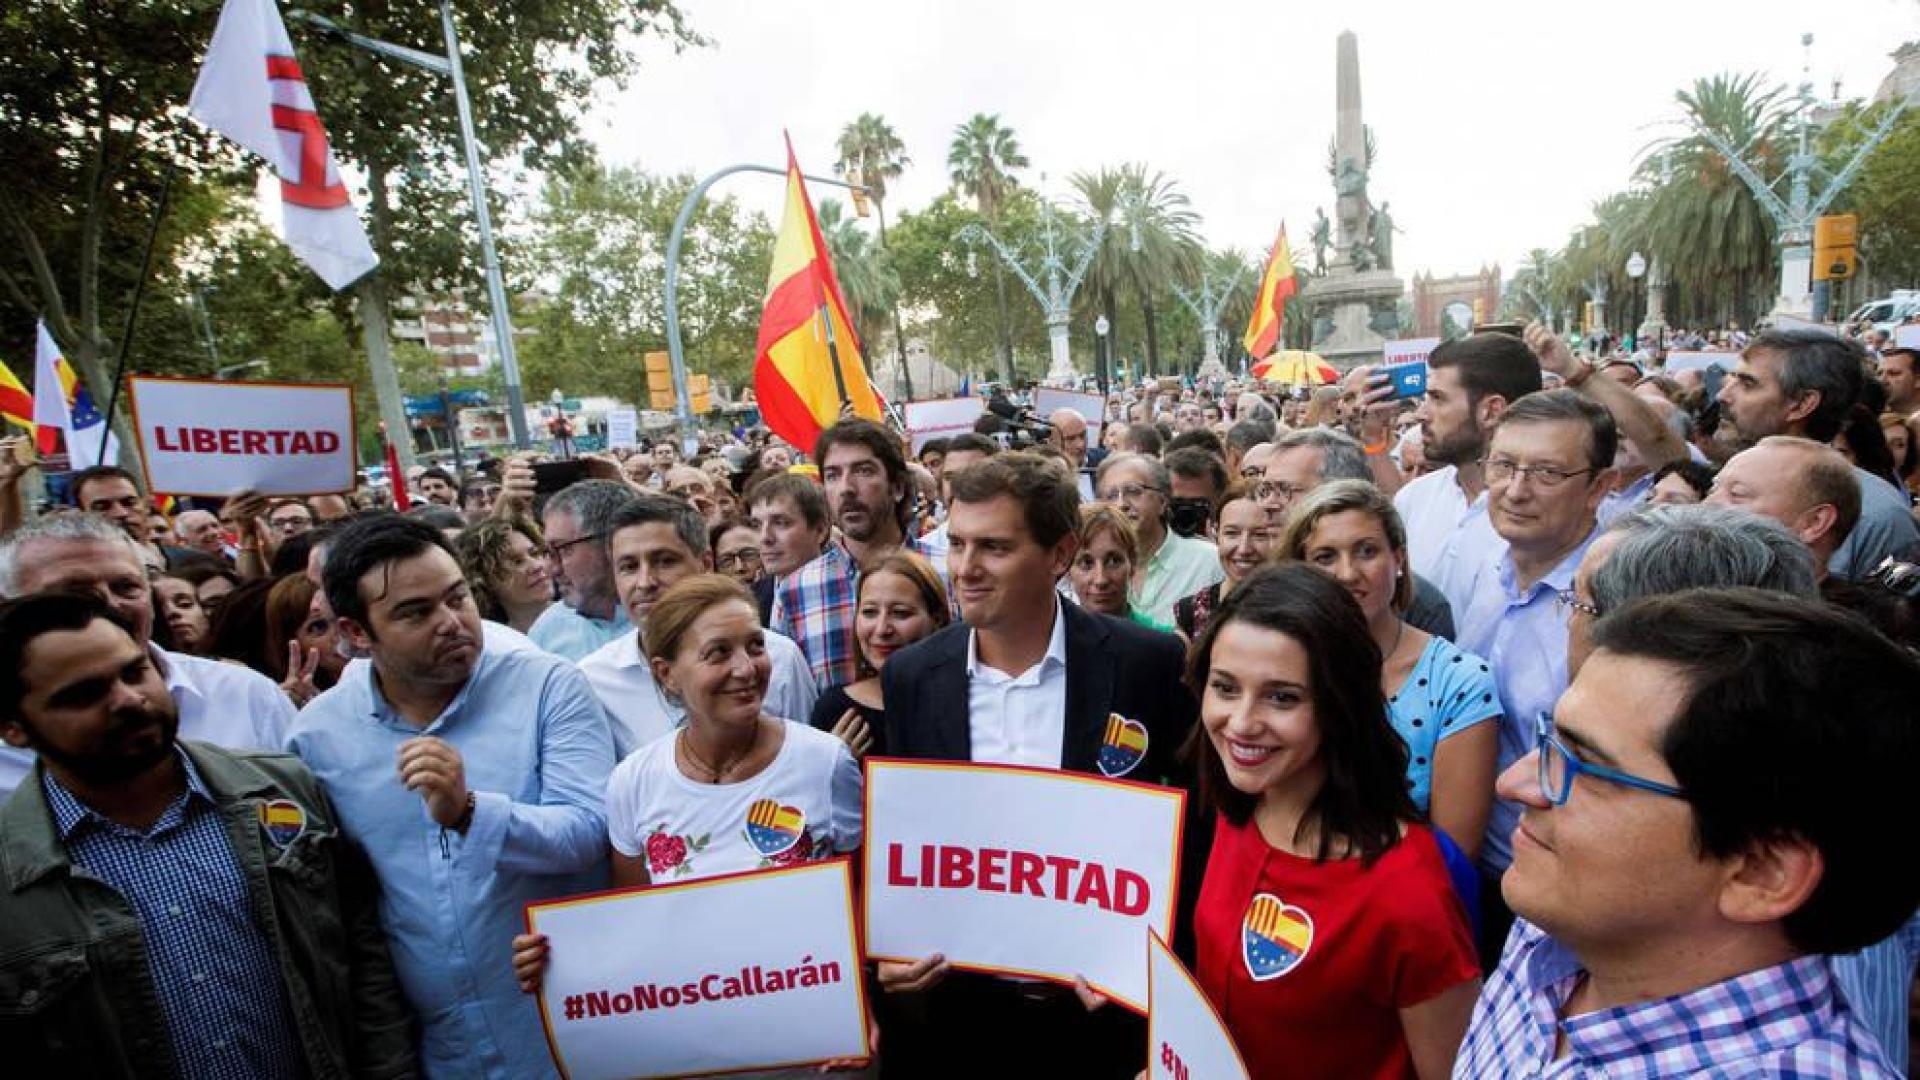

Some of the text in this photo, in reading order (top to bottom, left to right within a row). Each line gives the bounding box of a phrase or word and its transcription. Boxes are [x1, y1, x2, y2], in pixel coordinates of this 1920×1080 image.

[154, 426, 340, 454] LIBERTAD
[888, 843, 1151, 916] LIBERTAD
[564, 955, 841, 1020] #NoNosCallarán
